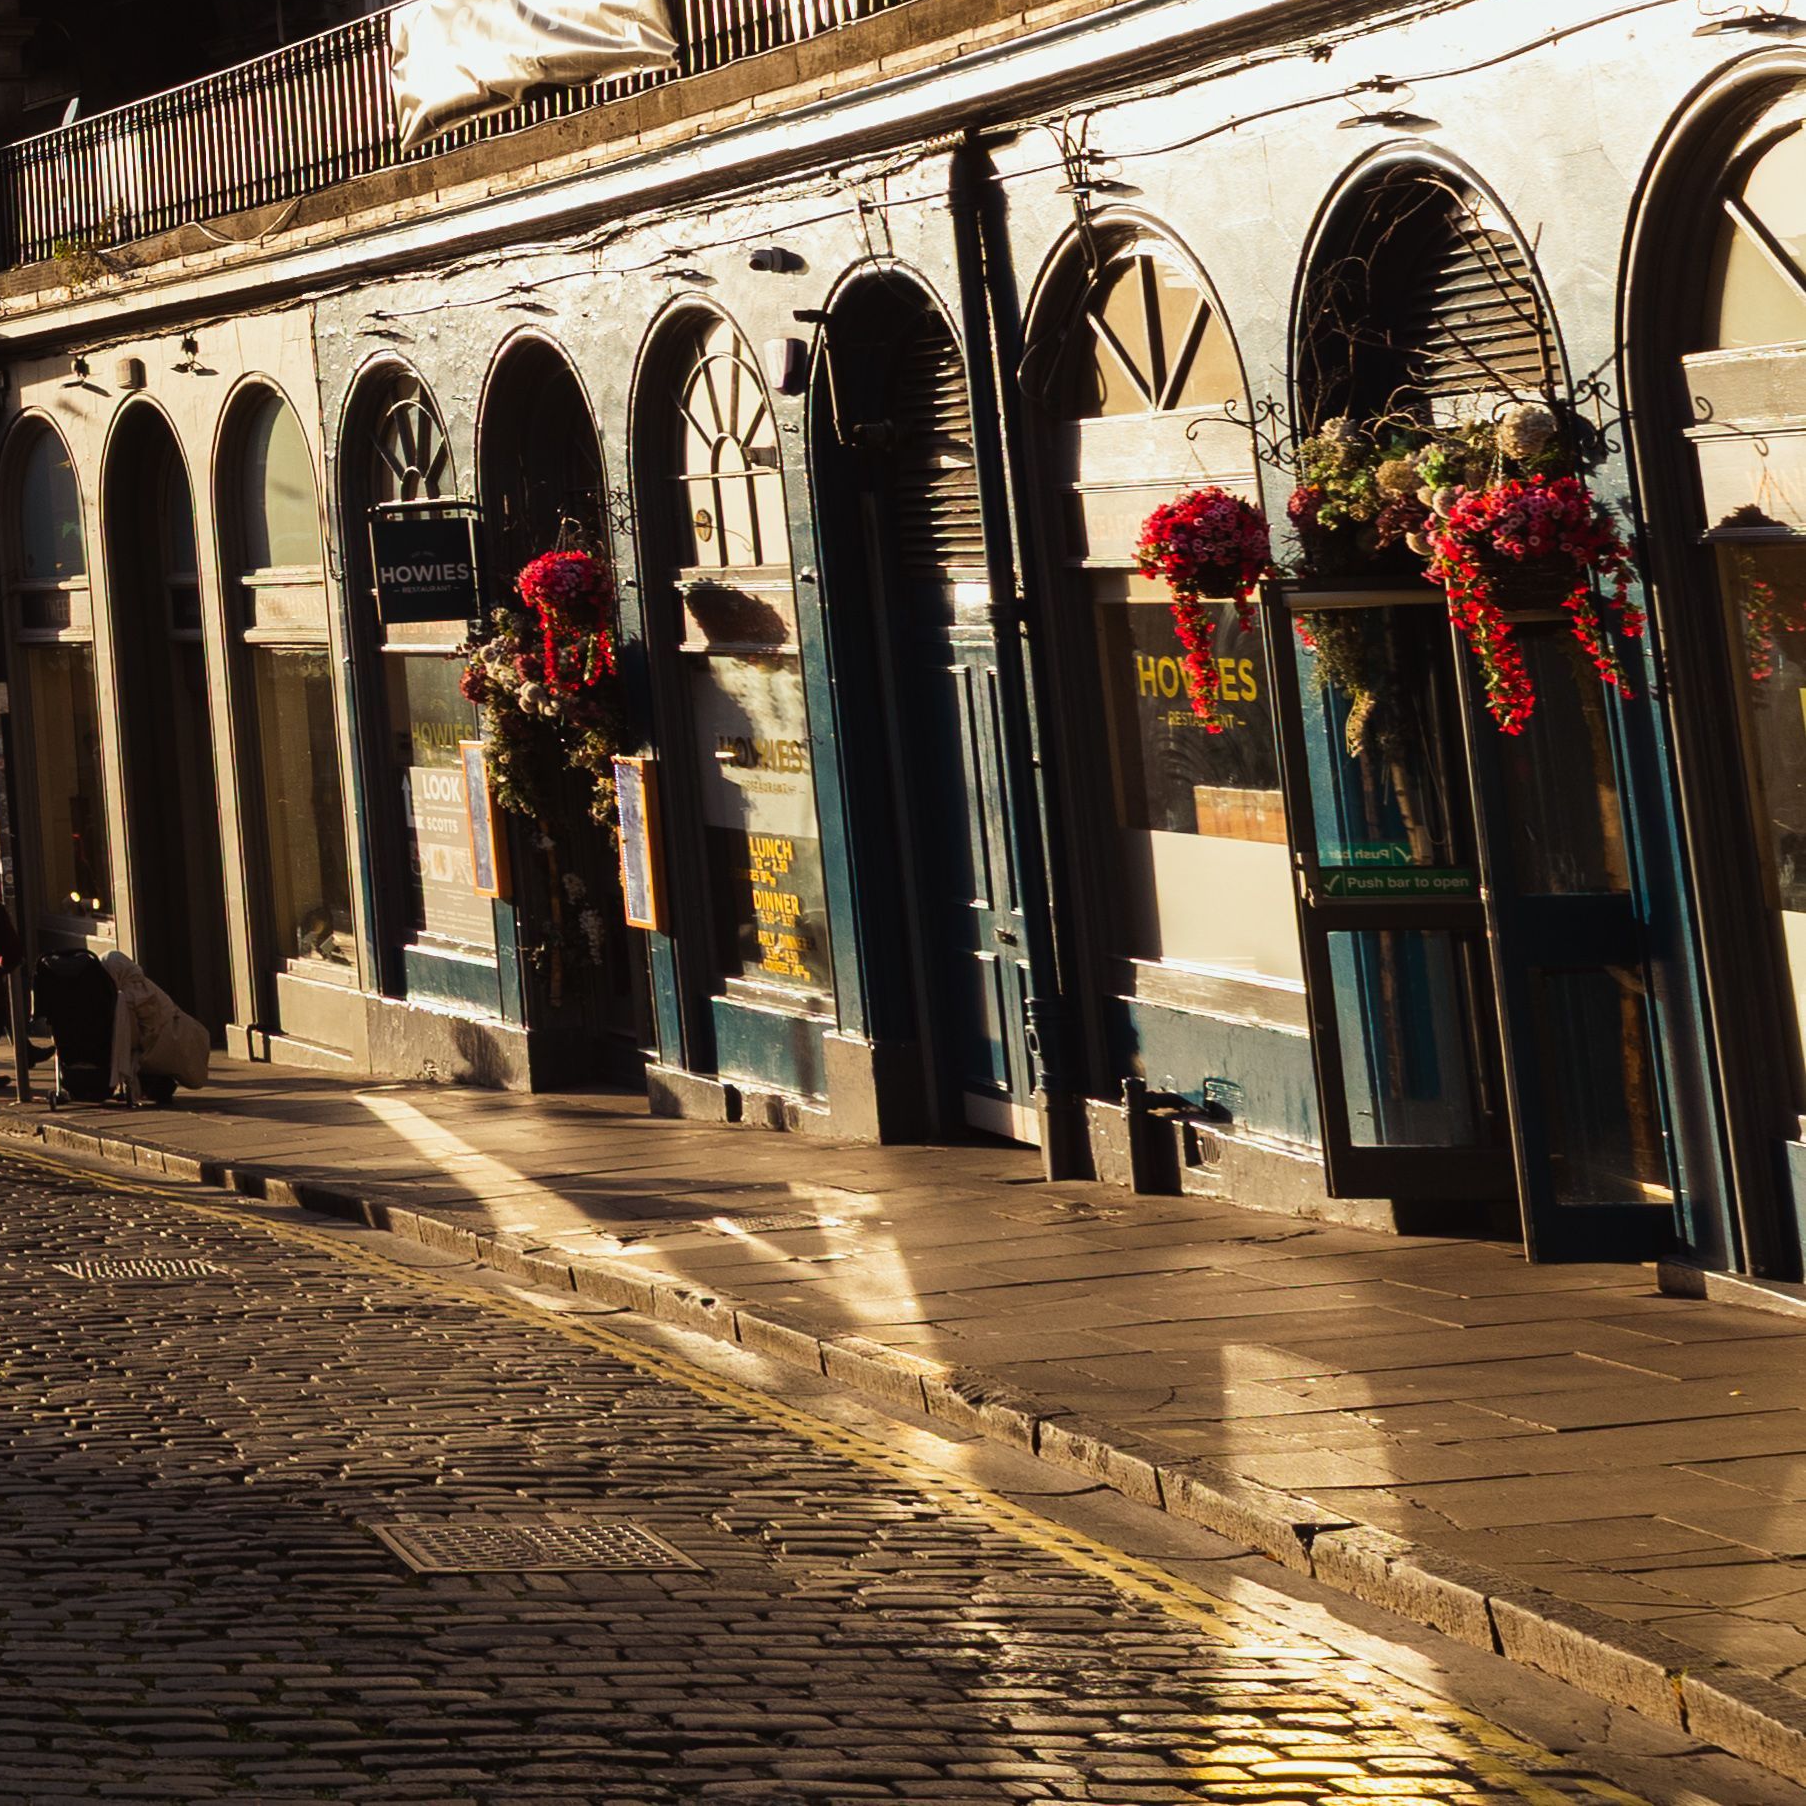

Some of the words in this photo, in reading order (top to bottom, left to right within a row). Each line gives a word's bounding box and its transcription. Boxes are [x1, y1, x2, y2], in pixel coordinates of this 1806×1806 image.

[379, 562, 469, 584] HOWIES
[401, 584, 452, 594] RESTAURANT
[422, 774, 463, 803] LOOK
[426, 817, 460, 835] SCOTTS
[748, 835, 793, 861] LUNCH
[1346, 877, 1384, 889] Push
[1387, 877, 1410, 888] bar
[1415, 877, 1430, 888] to
[1433, 877, 1469, 890] open
[752, 889, 801, 916] DINNER
